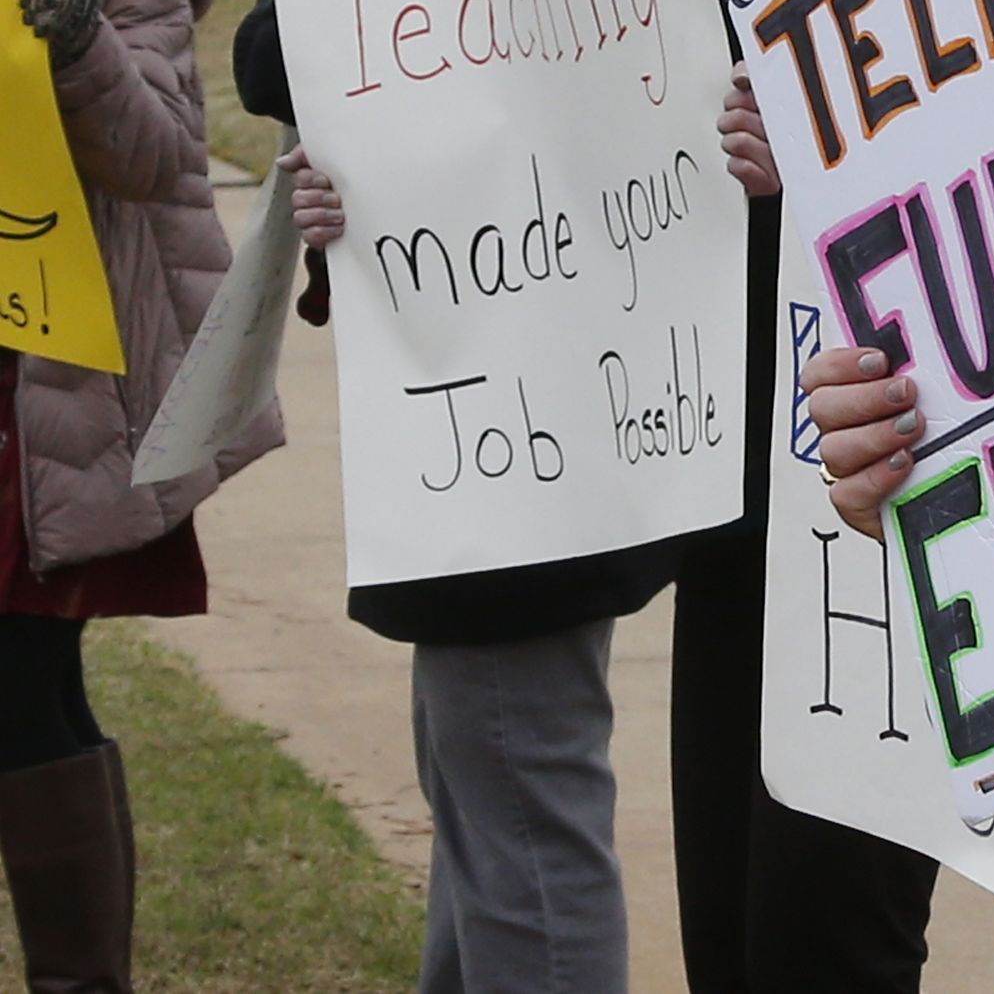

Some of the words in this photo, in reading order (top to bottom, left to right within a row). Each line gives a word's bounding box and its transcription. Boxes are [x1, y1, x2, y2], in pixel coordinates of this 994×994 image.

[0, 258, 50, 336] s!
[374, 153, 578, 313] made
[602, 149, 699, 311] your
[403, 374, 563, 492] Job
[599, 323, 722, 465] Possible
